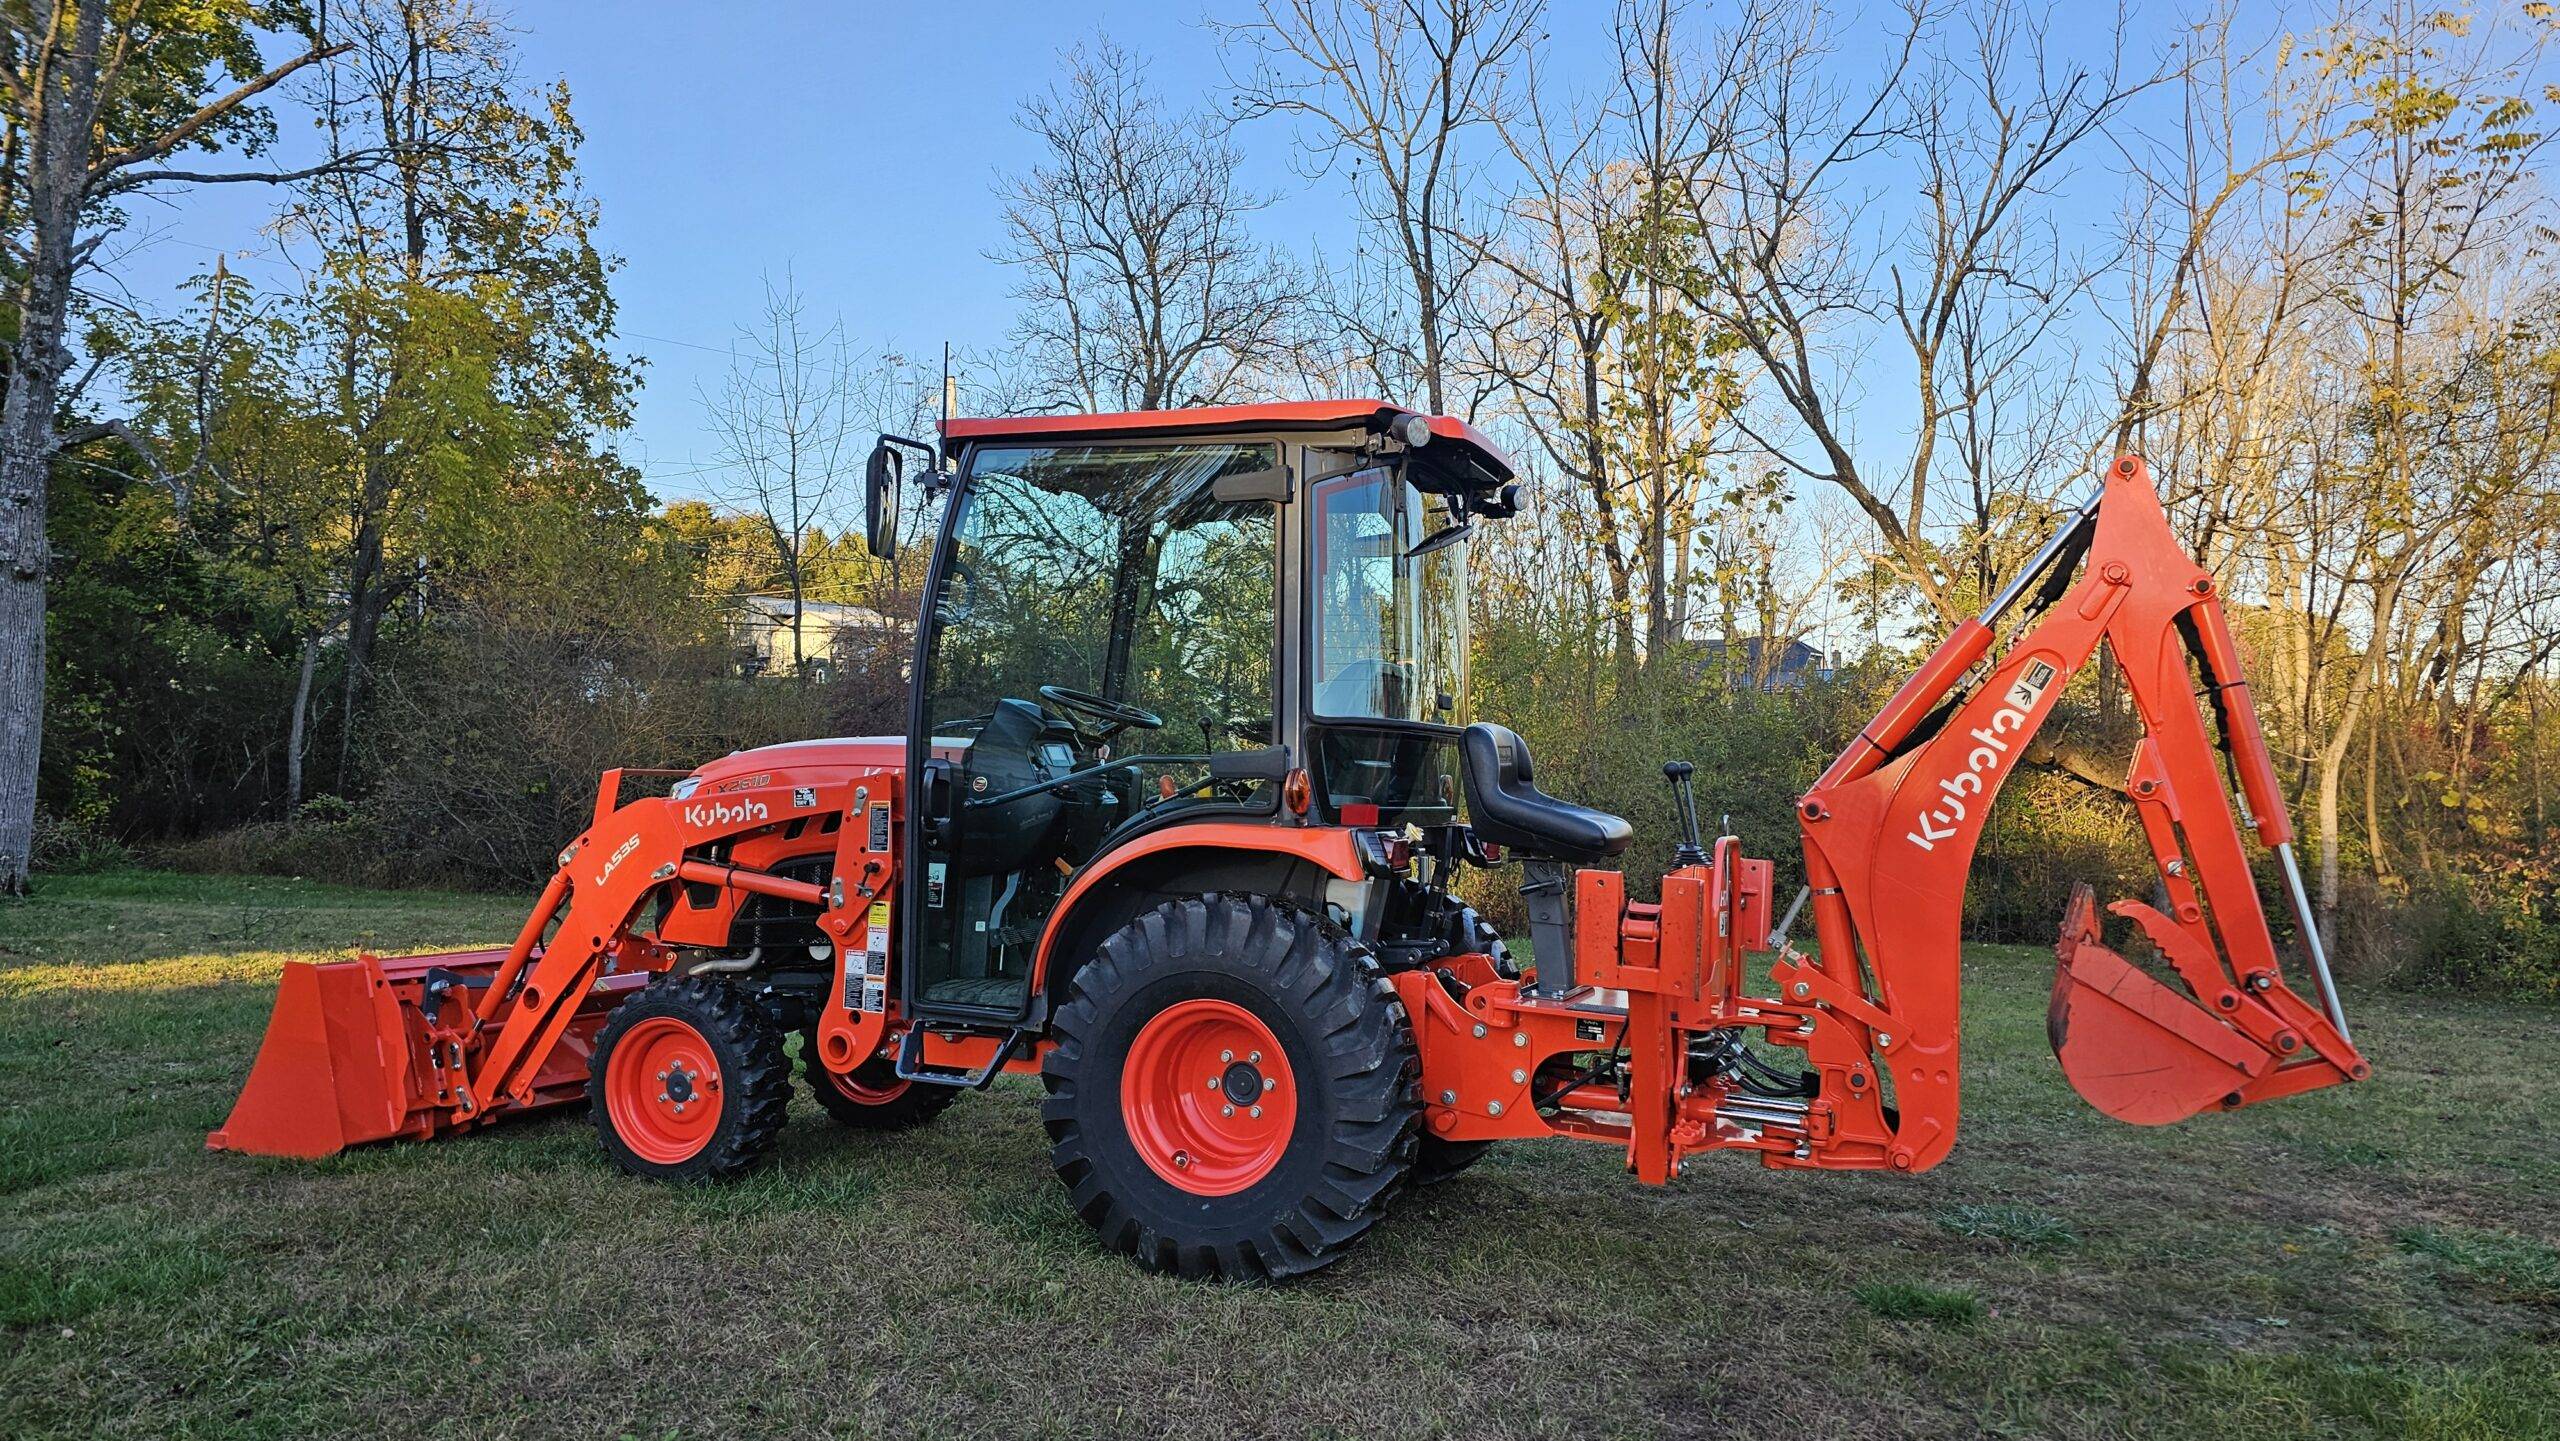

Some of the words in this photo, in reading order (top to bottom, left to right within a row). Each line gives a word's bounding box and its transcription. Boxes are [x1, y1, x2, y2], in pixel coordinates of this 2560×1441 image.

[1906, 708, 2026, 851] Kubota
[685, 798, 768, 827] Kubota
[595, 833, 640, 886] LA535
